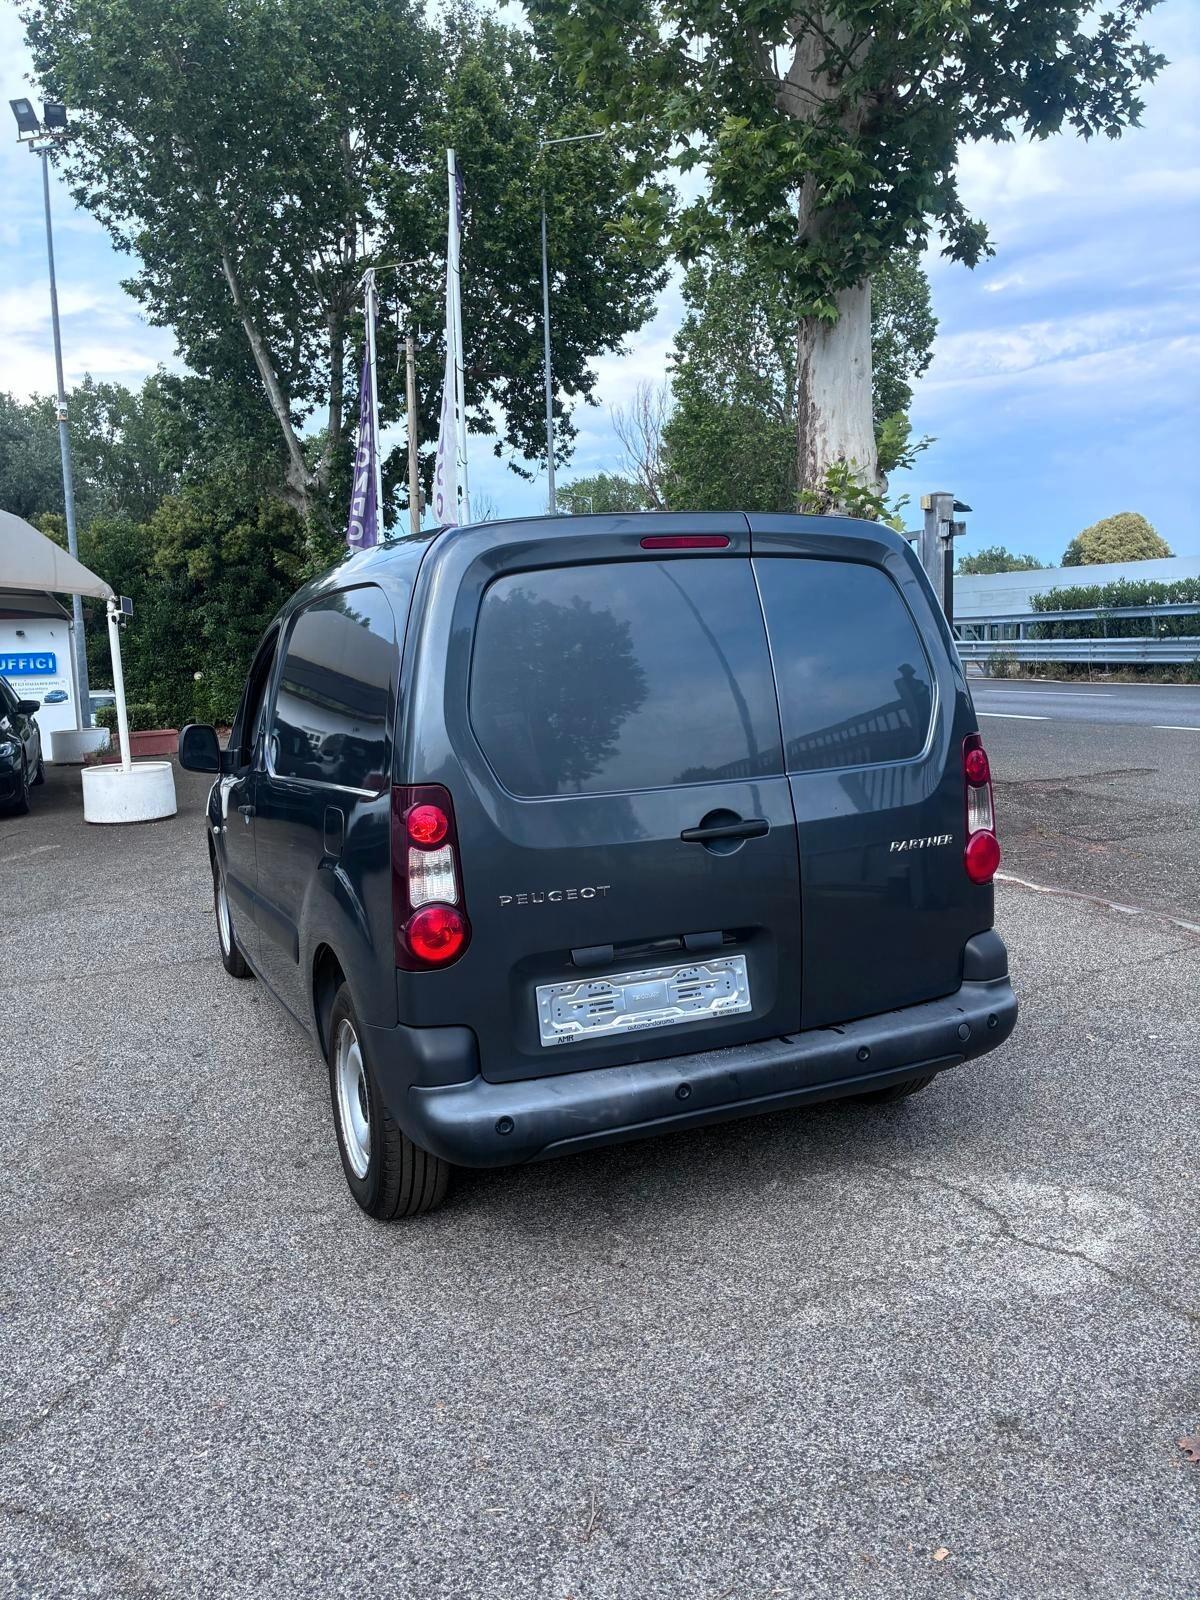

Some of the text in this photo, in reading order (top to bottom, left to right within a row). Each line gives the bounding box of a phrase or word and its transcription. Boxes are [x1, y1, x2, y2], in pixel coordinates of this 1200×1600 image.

[889, 834, 953, 852] PARTNER
[499, 885, 611, 907] PEUGEOT
[557, 1034, 574, 1044] AMR
